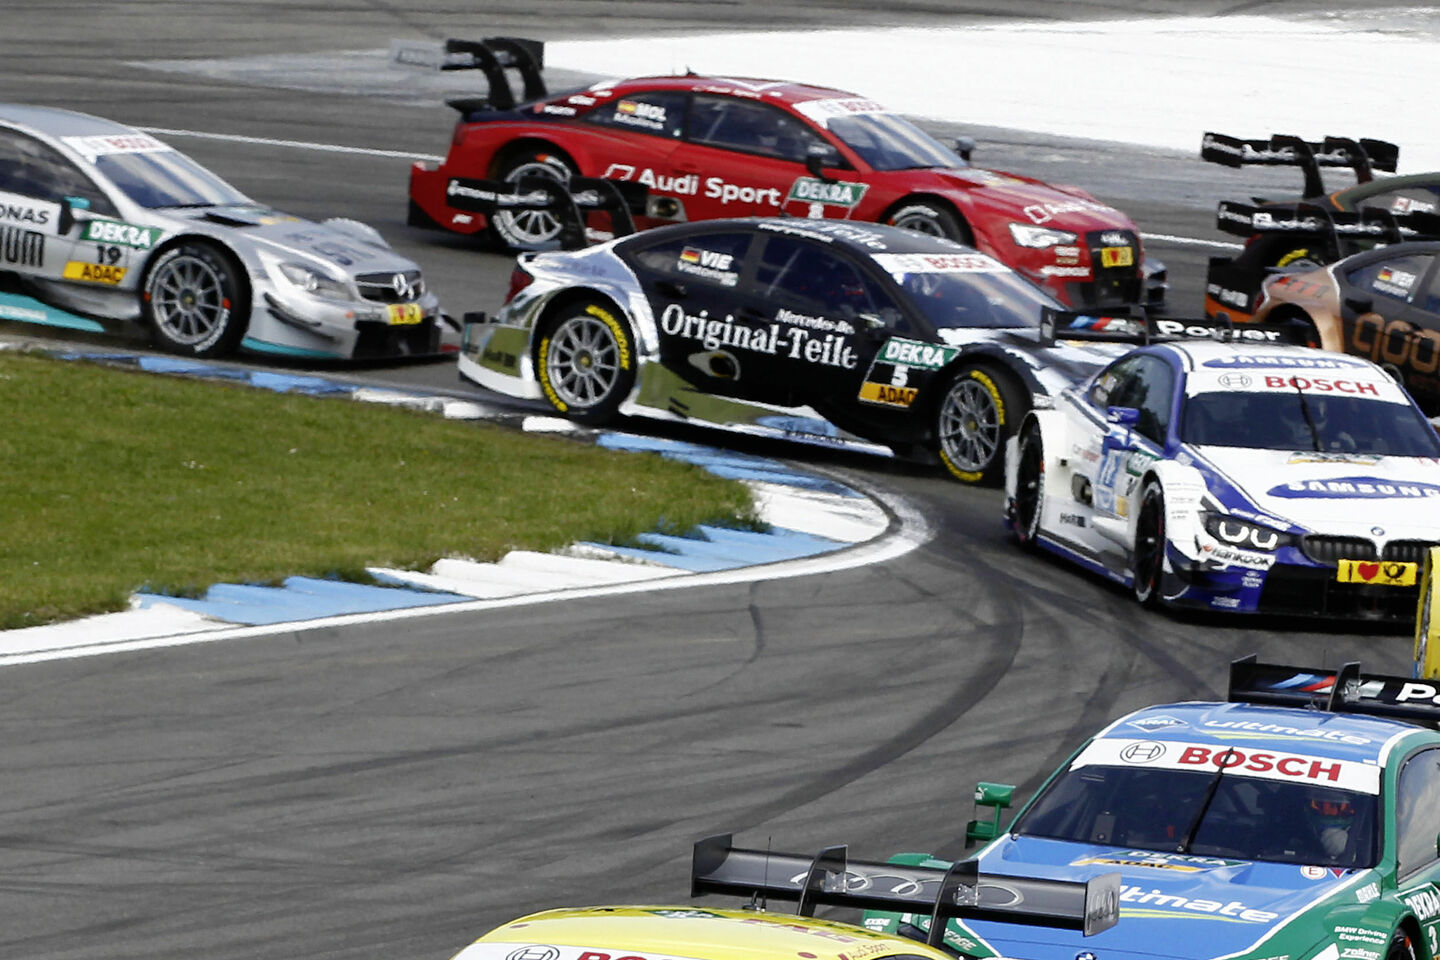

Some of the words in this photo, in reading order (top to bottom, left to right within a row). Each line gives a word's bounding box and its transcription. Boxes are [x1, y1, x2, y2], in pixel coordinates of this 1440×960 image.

[638, 168, 699, 195] Audi
[705, 177, 781, 207] Sport
[798, 181, 854, 204] DEKRA
[0, 205, 49, 224] NAS
[89, 221, 151, 248] DEKRA
[97, 245, 121, 265] 19
[701, 250, 734, 270] VIE
[82, 265, 122, 283] ADAC
[885, 341, 945, 367] DEKRA
[1219, 355, 1355, 370] SAMSUNG
[891, 364, 909, 388] 5
[1264, 375, 1380, 396] BOSCH
[877, 387, 917, 406] ADAC
[1204, 719, 1371, 745] ultimate
[1177, 746, 1342, 782] BOSCH
[1127, 851, 1227, 866] DEKRA
[1120, 884, 1279, 923] ltimate
[1335, 926, 1358, 935] BMW
[1358, 927, 1388, 939] Driving
[1339, 933, 1386, 945] Experience
[1428, 925, 1439, 955] 3
